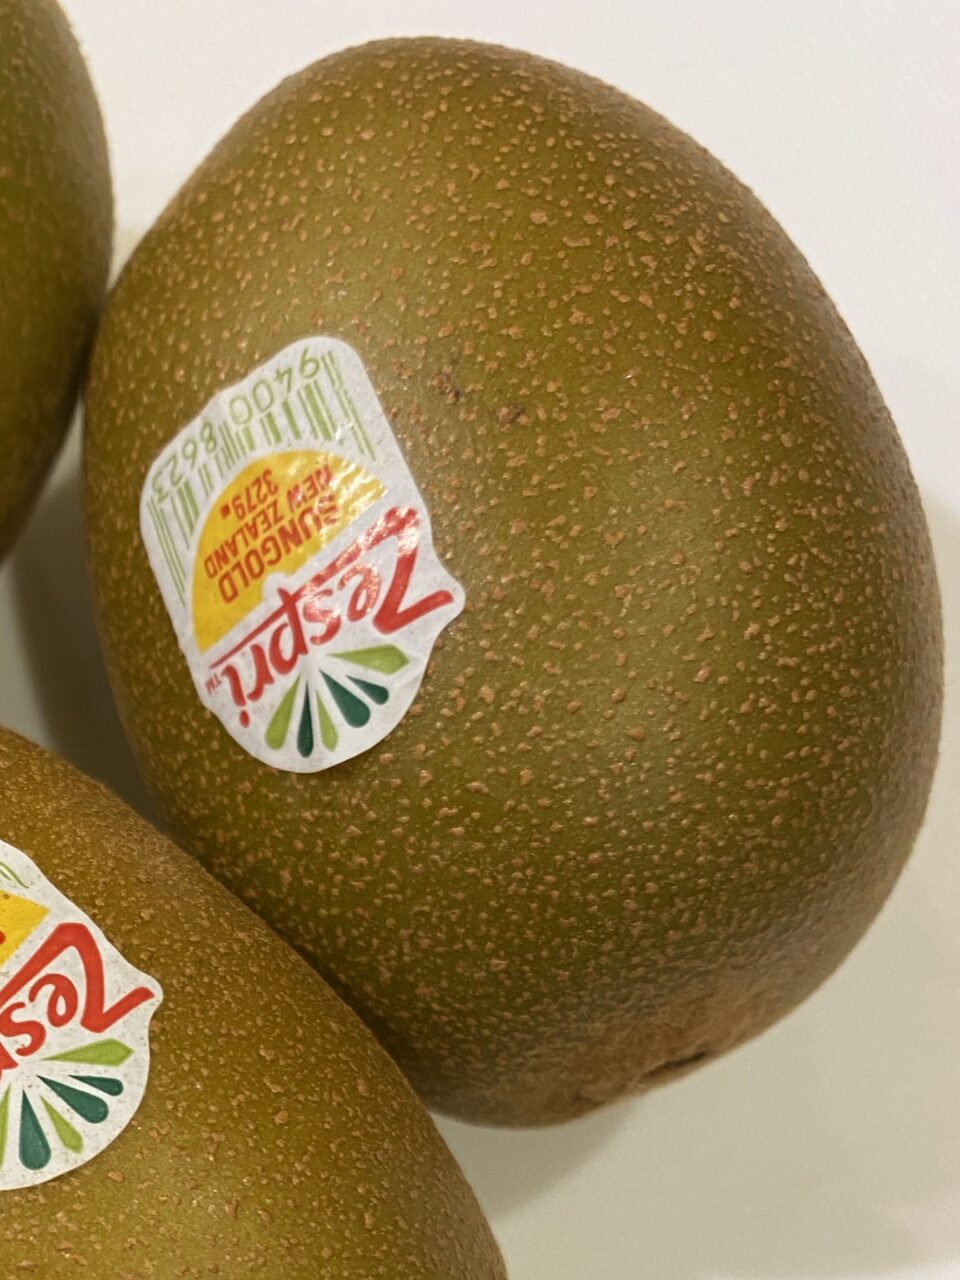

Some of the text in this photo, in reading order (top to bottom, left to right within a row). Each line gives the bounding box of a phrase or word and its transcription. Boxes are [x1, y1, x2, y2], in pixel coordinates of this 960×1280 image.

[152, 347, 320, 502] 9400 8623
[203, 465, 333, 580] NEW ZEALAND
[217, 494, 340, 604] SUNGOLD
[231, 468, 279, 520] 3279
[210, 506, 454, 728] Zespri
